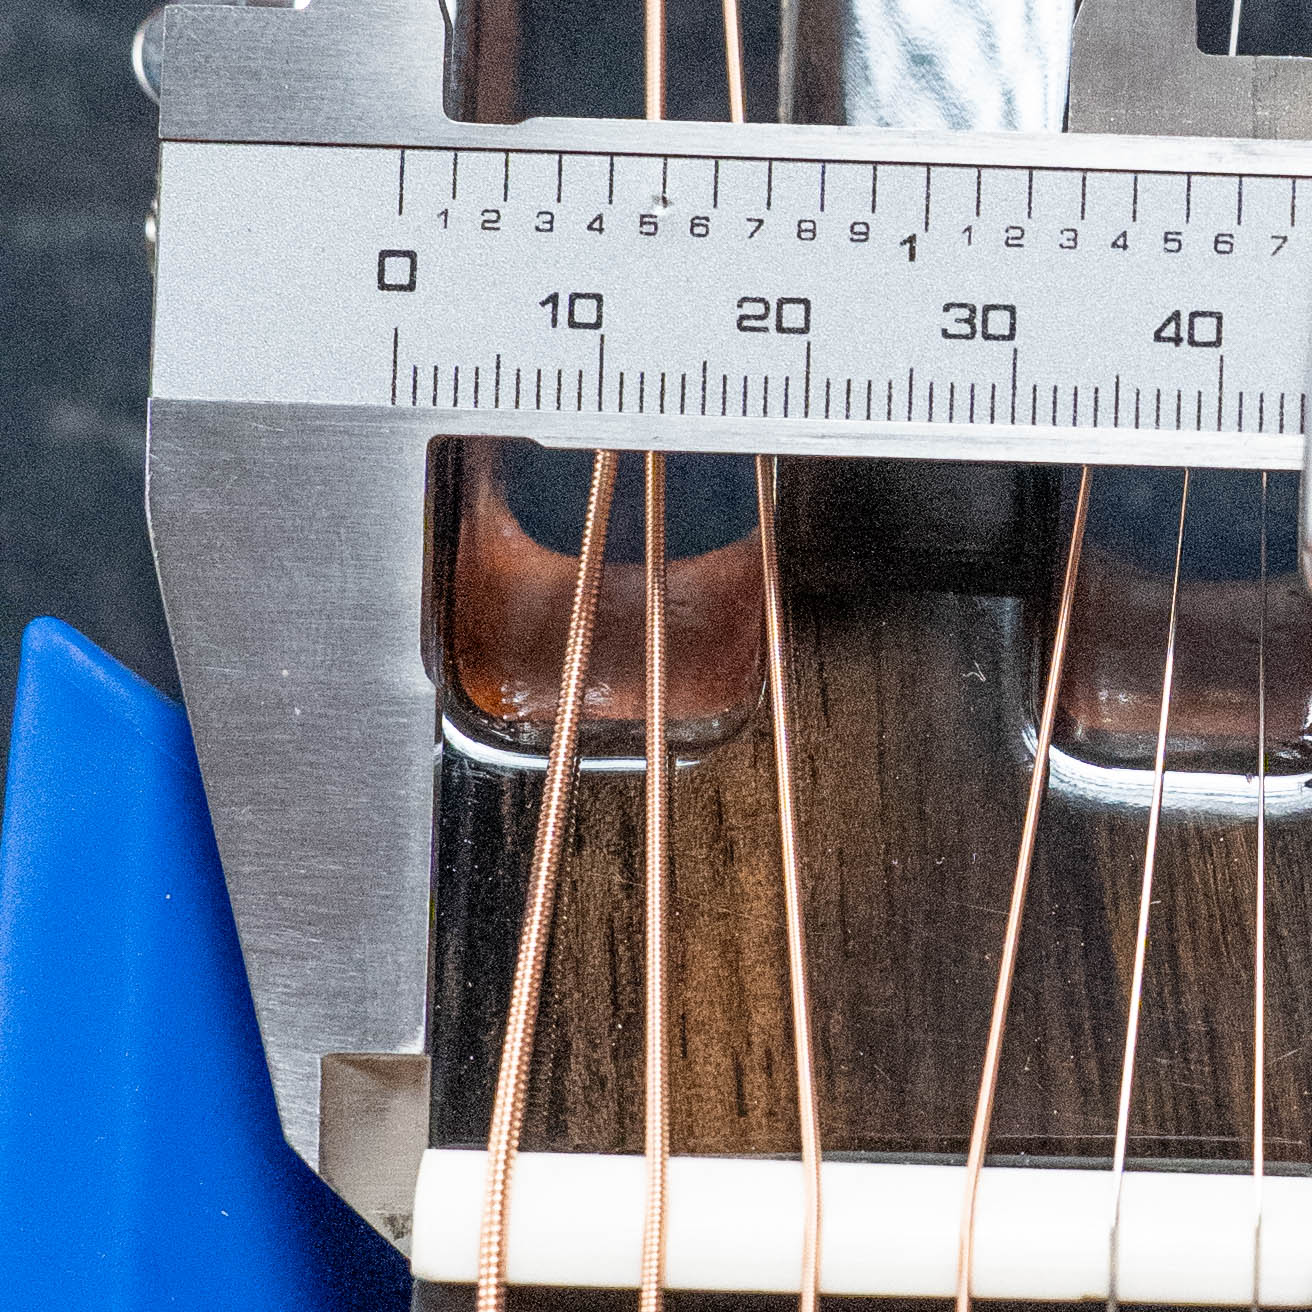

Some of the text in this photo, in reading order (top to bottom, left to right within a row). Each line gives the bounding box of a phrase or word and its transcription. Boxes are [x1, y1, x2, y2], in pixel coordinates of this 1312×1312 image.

[438, 208, 1289, 262] 1 2 3 4 5 6 7 8 9 1 1 2 3 4 5 6 7
[376, 249, 1224, 349] 0 10 20 30 40
